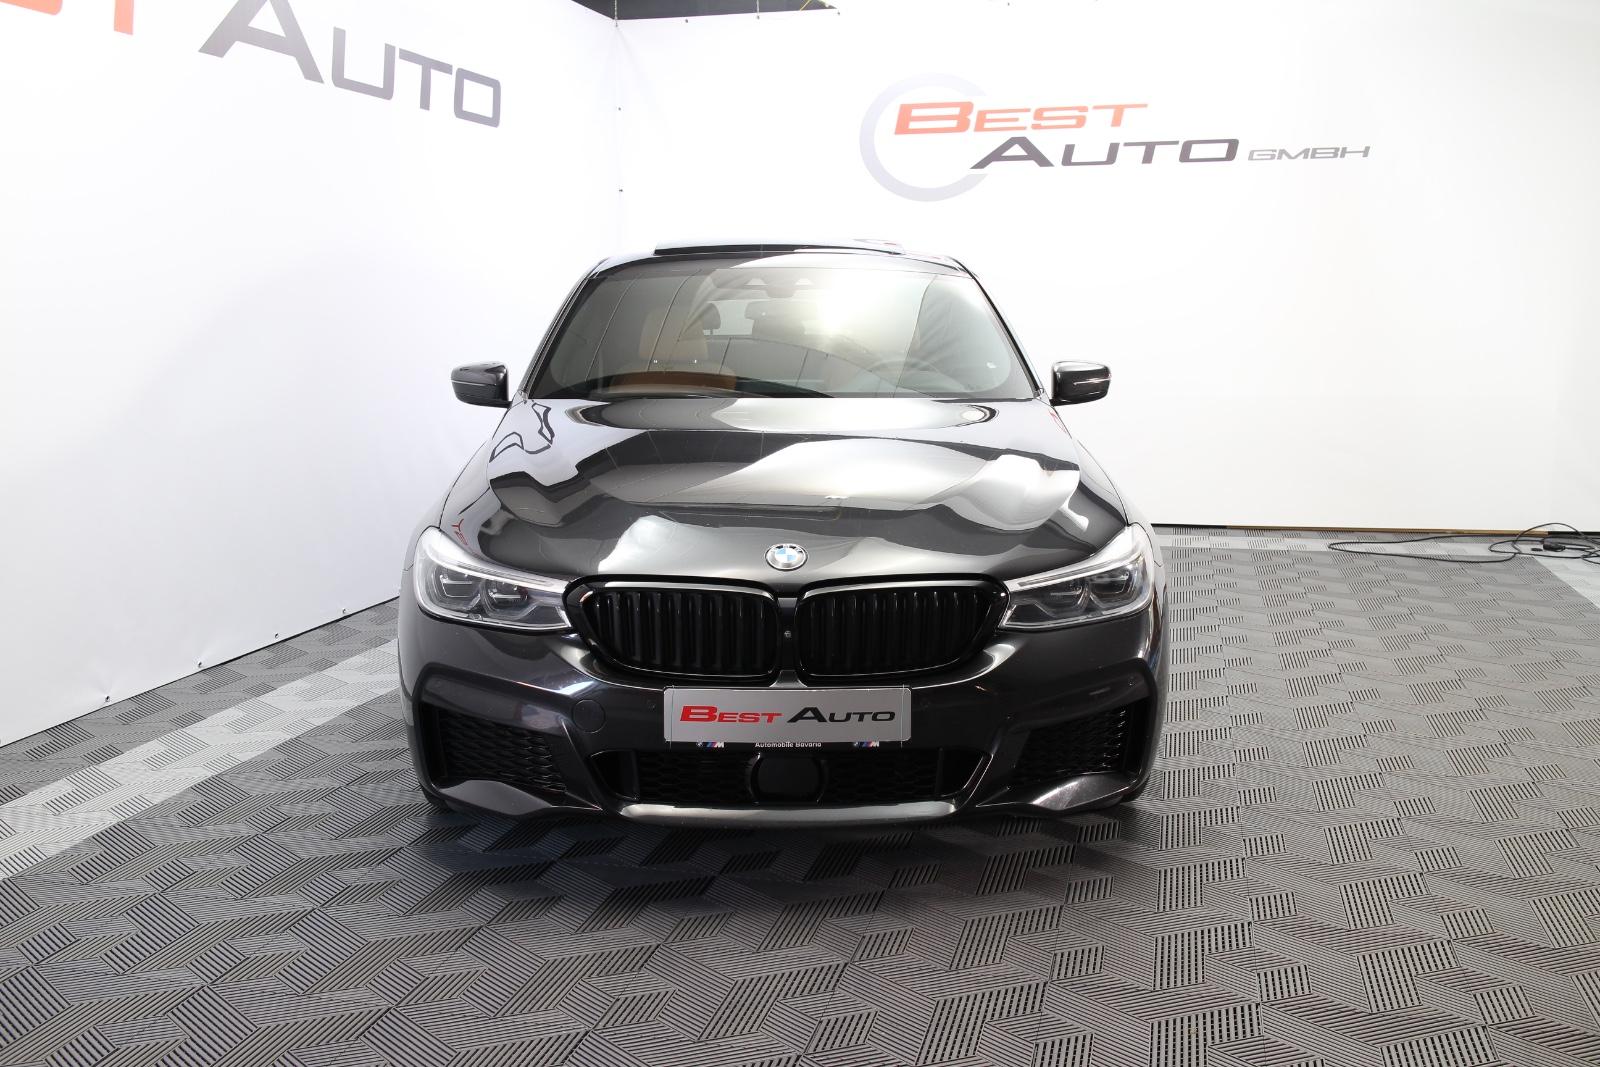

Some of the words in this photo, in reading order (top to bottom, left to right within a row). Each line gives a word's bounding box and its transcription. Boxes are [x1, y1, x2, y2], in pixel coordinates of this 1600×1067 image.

[199, 0, 501, 128] AUTO
[895, 101, 1148, 135] BEST
[970, 136, 1240, 170] AUTO
[1248, 146, 1371, 161] GMBH
[680, 705, 784, 723] BEST
[787, 706, 896, 723] AUTO
